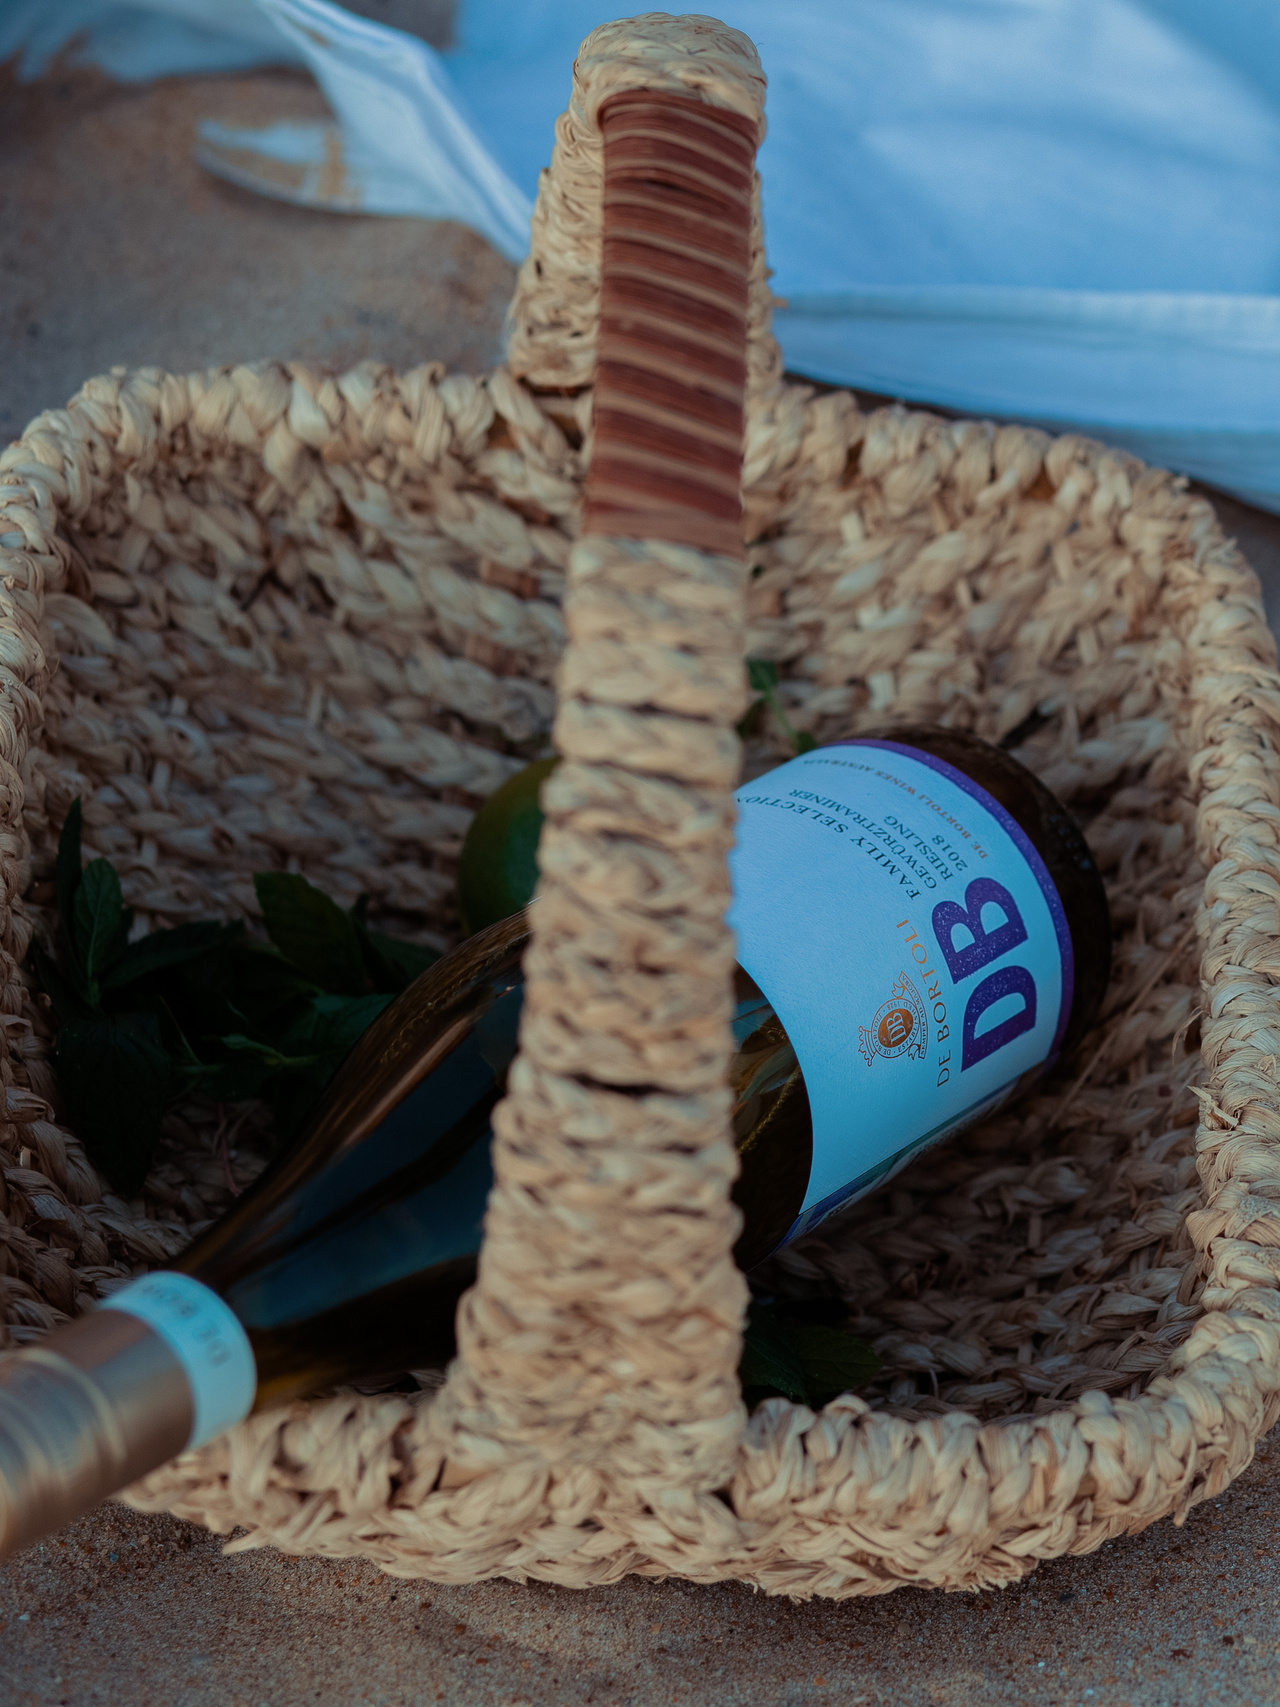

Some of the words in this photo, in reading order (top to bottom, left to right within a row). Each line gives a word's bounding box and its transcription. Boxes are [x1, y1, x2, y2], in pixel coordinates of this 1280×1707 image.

[876, 770, 916, 795] WINES
[918, 794, 971, 840] BORTOLI
[849, 835, 922, 900] FAMILY
[883, 815, 954, 881] RIESLING
[932, 835, 968, 872] 2018
[971, 841, 988, 859] DE
[896, 919, 950, 1043] BORTOLI
[931, 877, 1037, 1073] DB
[886, 1012, 907, 1045] DB
[937, 1049, 951, 1088] DE
